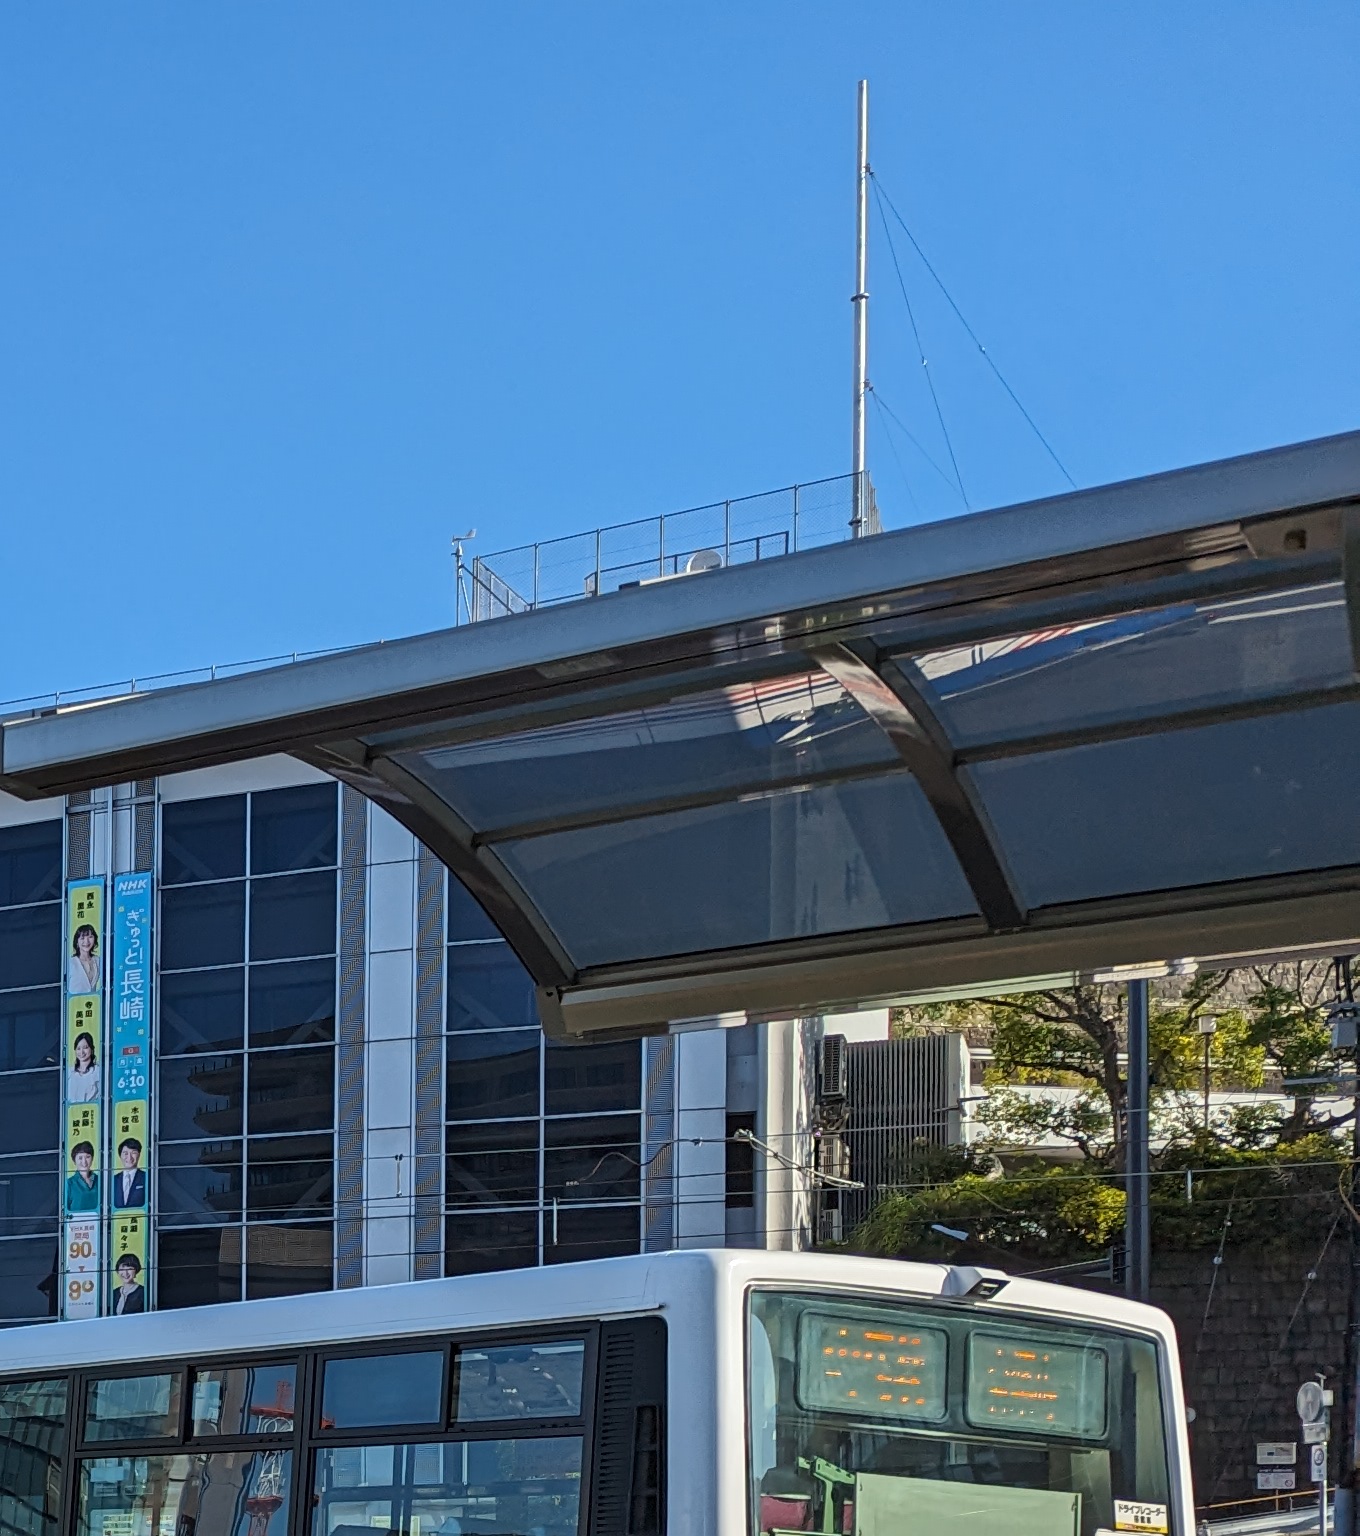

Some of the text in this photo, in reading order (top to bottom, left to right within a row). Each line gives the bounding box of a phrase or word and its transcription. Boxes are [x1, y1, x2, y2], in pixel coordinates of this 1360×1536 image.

[118, 879, 147, 892] NHK
[118, 1075, 145, 1088] 6:10
[1118, 1503, 1166, 1517] ドライブレコーダー
